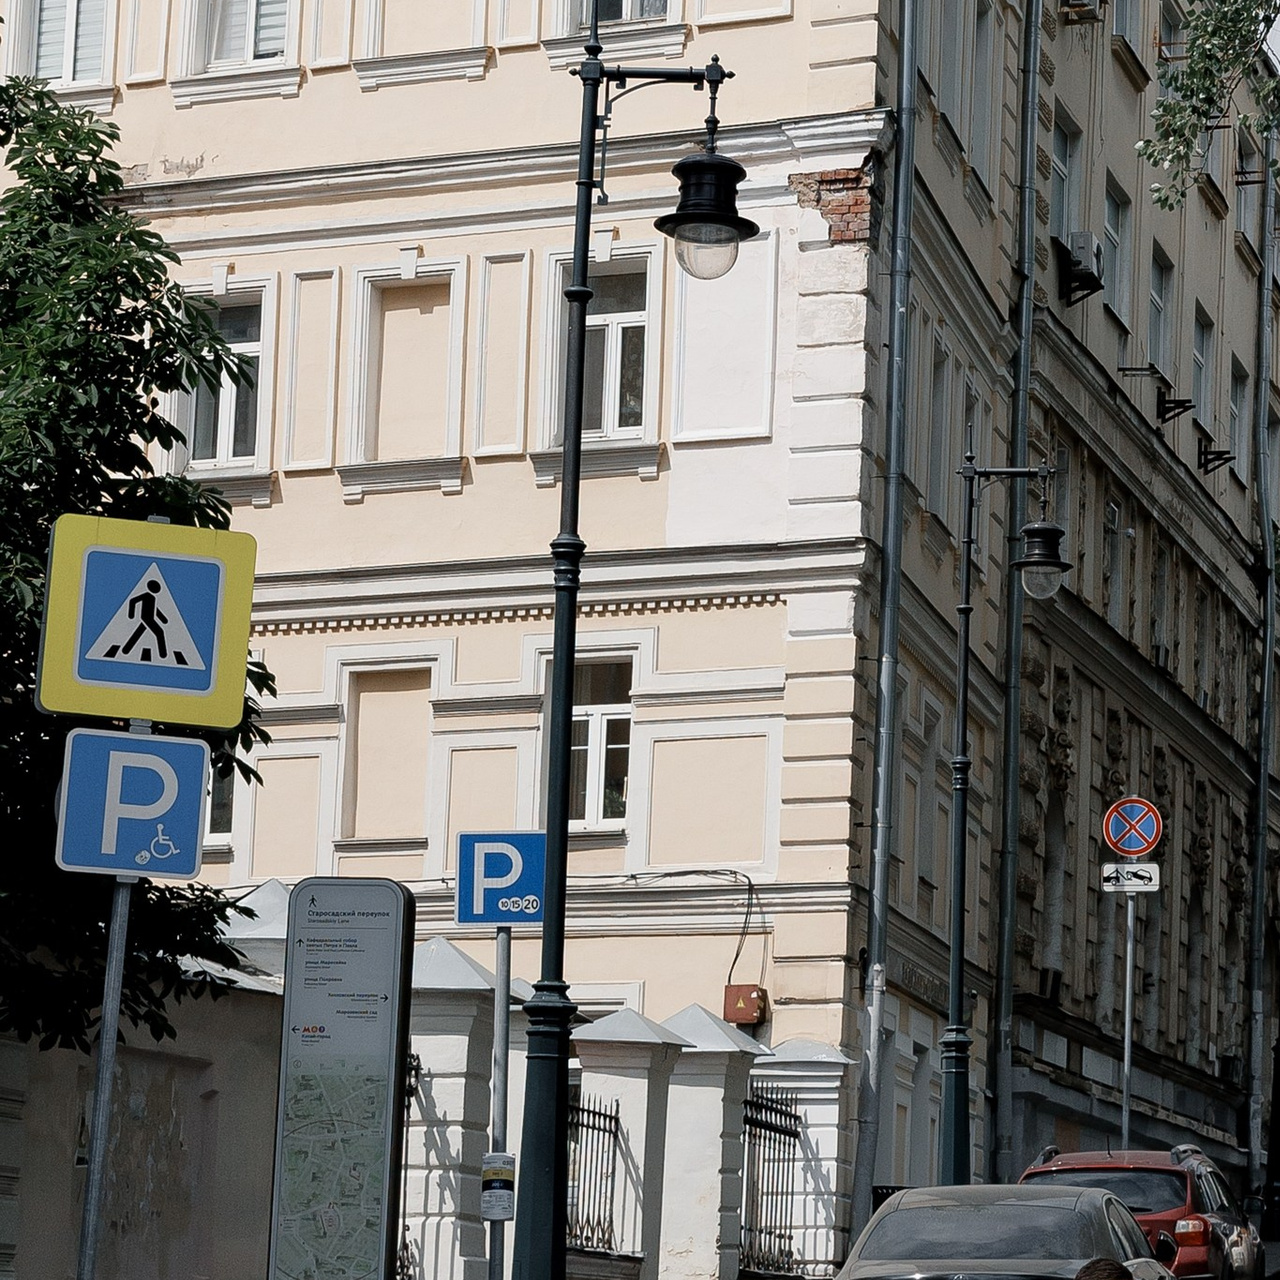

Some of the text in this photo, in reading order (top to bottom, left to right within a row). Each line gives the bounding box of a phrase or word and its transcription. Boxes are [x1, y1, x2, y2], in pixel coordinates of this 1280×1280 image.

[101, 751, 178, 854] P
[473, 842, 523, 914] P
[308, 910, 355, 918] Старосадский
[511, 900, 520, 908] 15
[523, 898, 539, 910] 20
